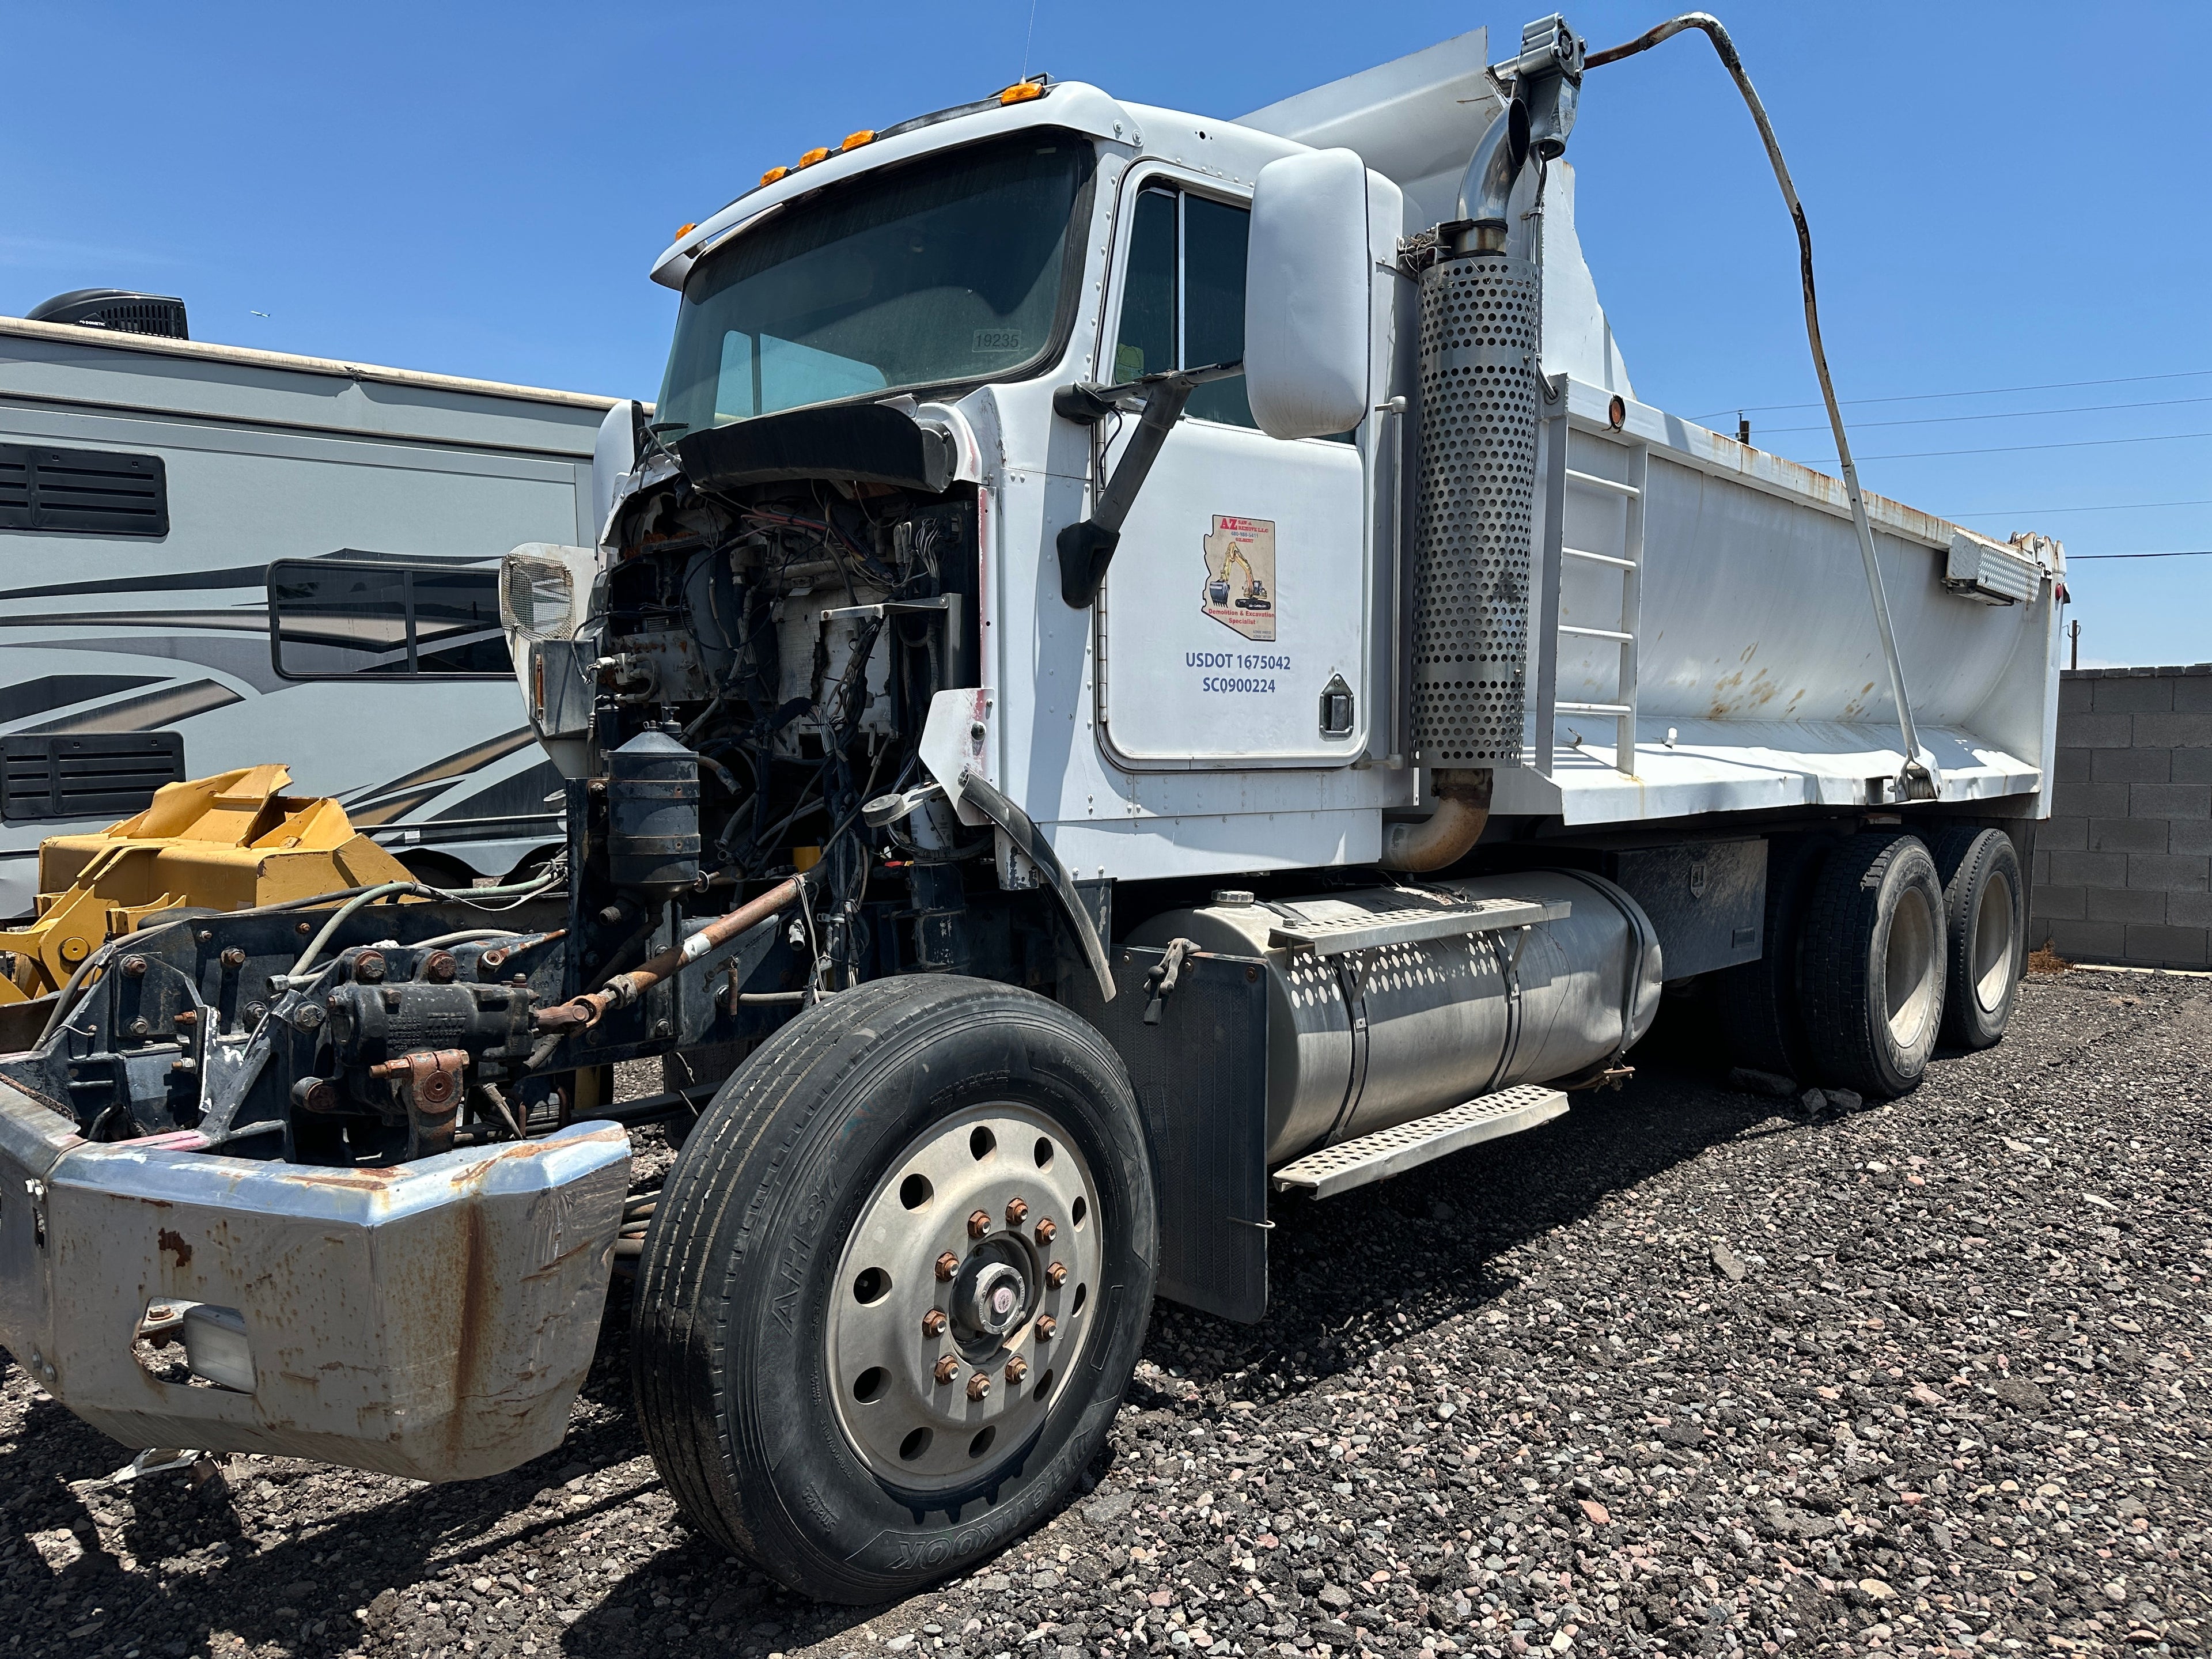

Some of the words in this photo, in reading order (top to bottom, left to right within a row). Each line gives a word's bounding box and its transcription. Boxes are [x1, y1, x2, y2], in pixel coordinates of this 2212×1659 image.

[976, 334, 1019, 348] 19235
[1220, 518, 1237, 530] AZ
[1185, 652, 1233, 668] USDOT
[1237, 654, 1291, 670] 1675042
[1203, 677, 1275, 693] SC0900224
[1062, 1055, 1102, 1089] Regional
[1100, 1088, 1119, 1113] Haul
